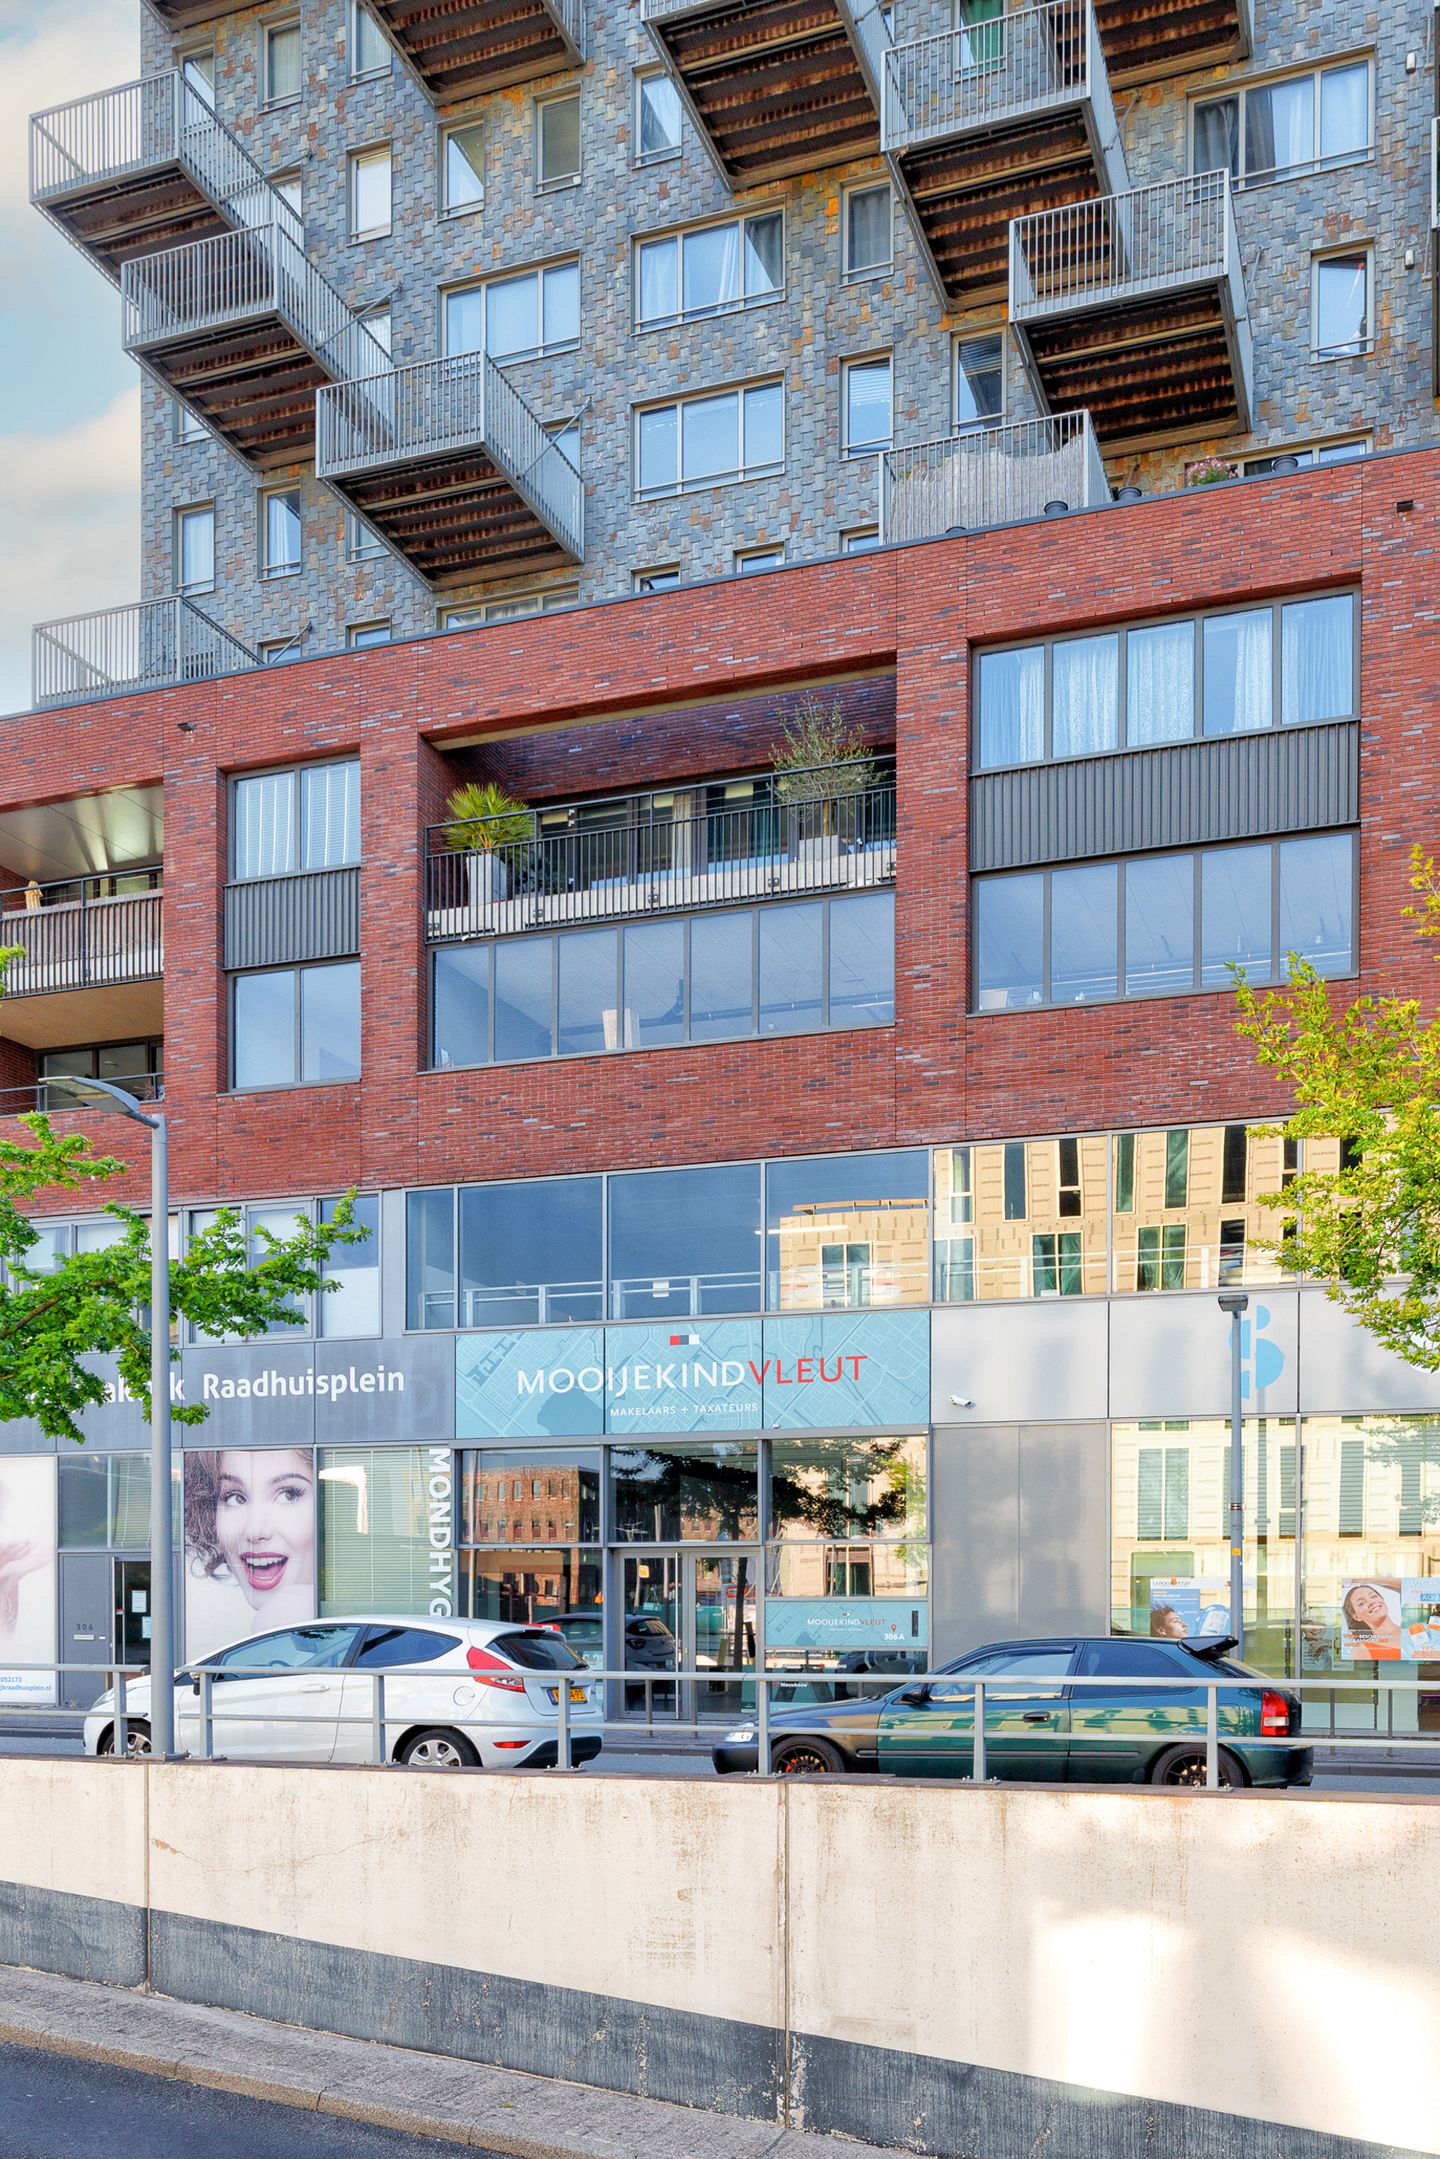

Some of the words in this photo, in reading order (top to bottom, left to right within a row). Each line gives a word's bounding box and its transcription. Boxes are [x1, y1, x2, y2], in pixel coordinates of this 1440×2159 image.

[203, 1365, 405, 1402] Raadhuisplein
[610, 1405, 676, 1416] MAKELAARS
[693, 1402, 758, 1413] TAXATEURS
[76, 1623, 94, 1631] 306
